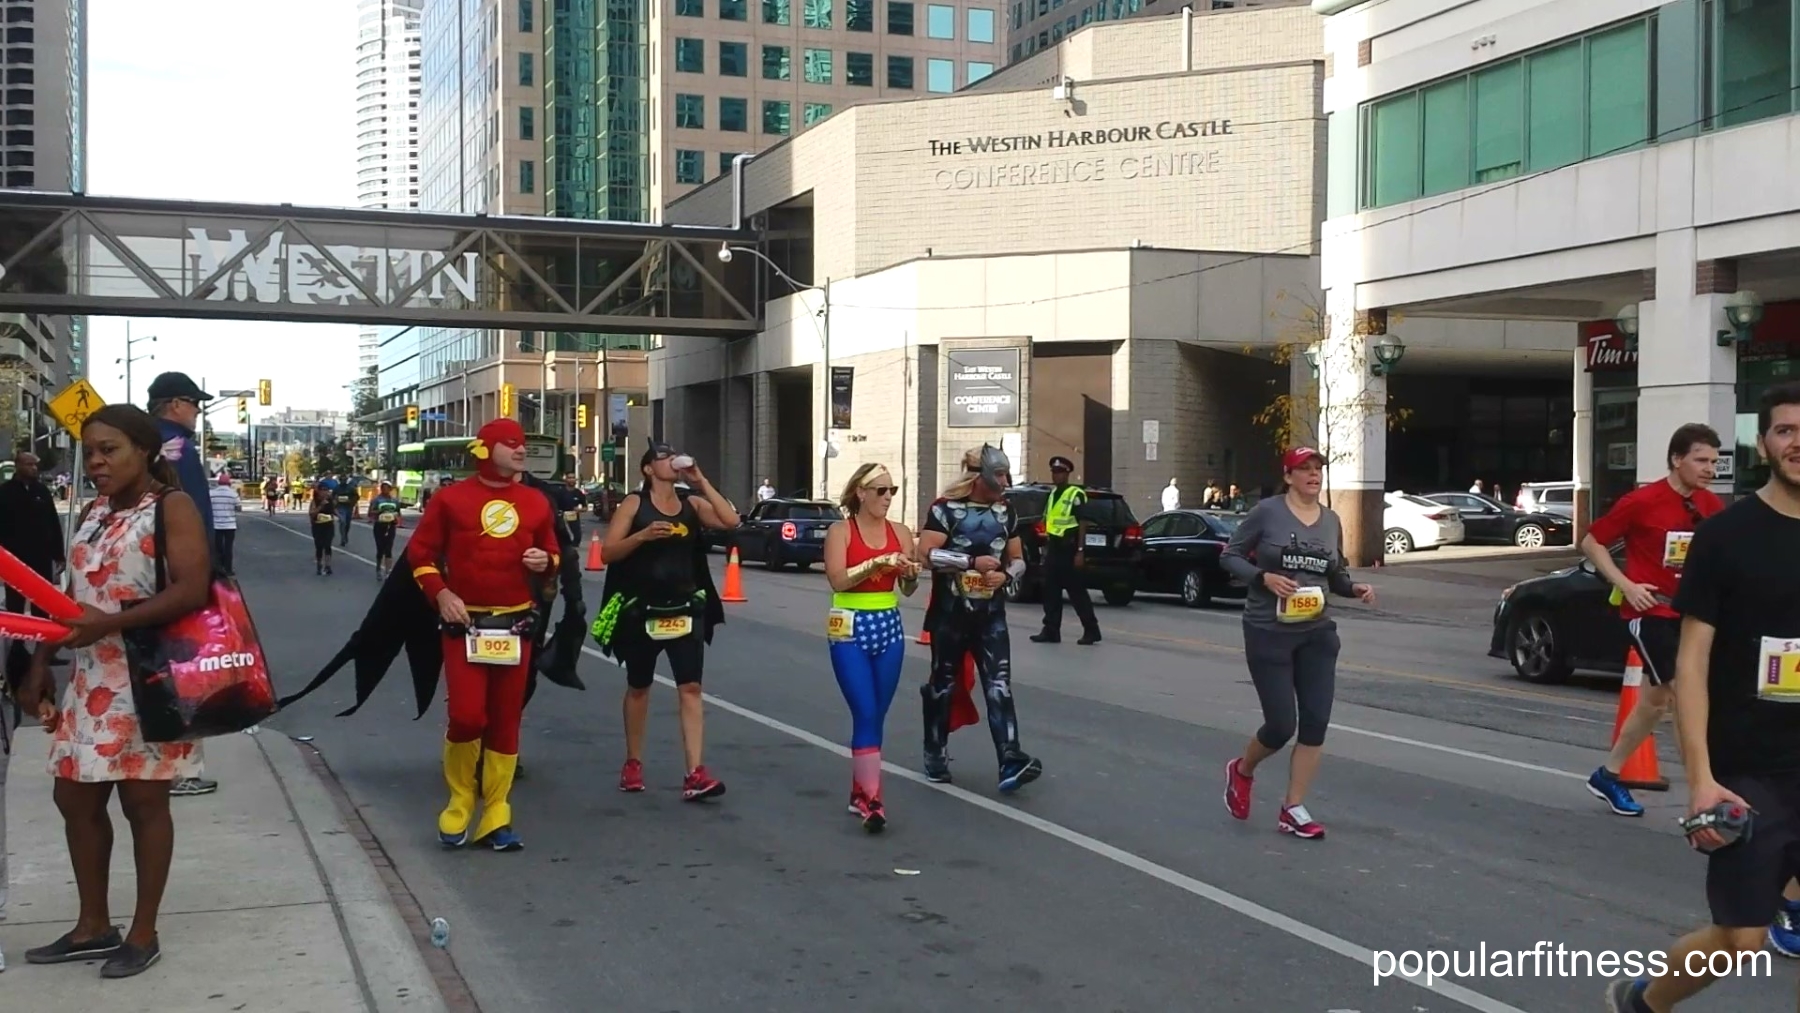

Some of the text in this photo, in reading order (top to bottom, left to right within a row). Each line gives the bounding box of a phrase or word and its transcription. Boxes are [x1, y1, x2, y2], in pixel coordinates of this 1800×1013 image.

[929, 119, 1233, 156] THE WESTIN HARBOUR CASTLE
[935, 150, 1220, 191] CONFERENCE CENTRE
[1589, 334, 1622, 366] Tim
[954, 395, 1011, 413] CONFERENCE CENTRE
[1282, 554, 1329, 569] MARITIME
[1291, 597, 1319, 608] 1583
[658, 619, 686, 628] 2243
[484, 640, 511, 651] 902
[200, 651, 255, 672] metro
